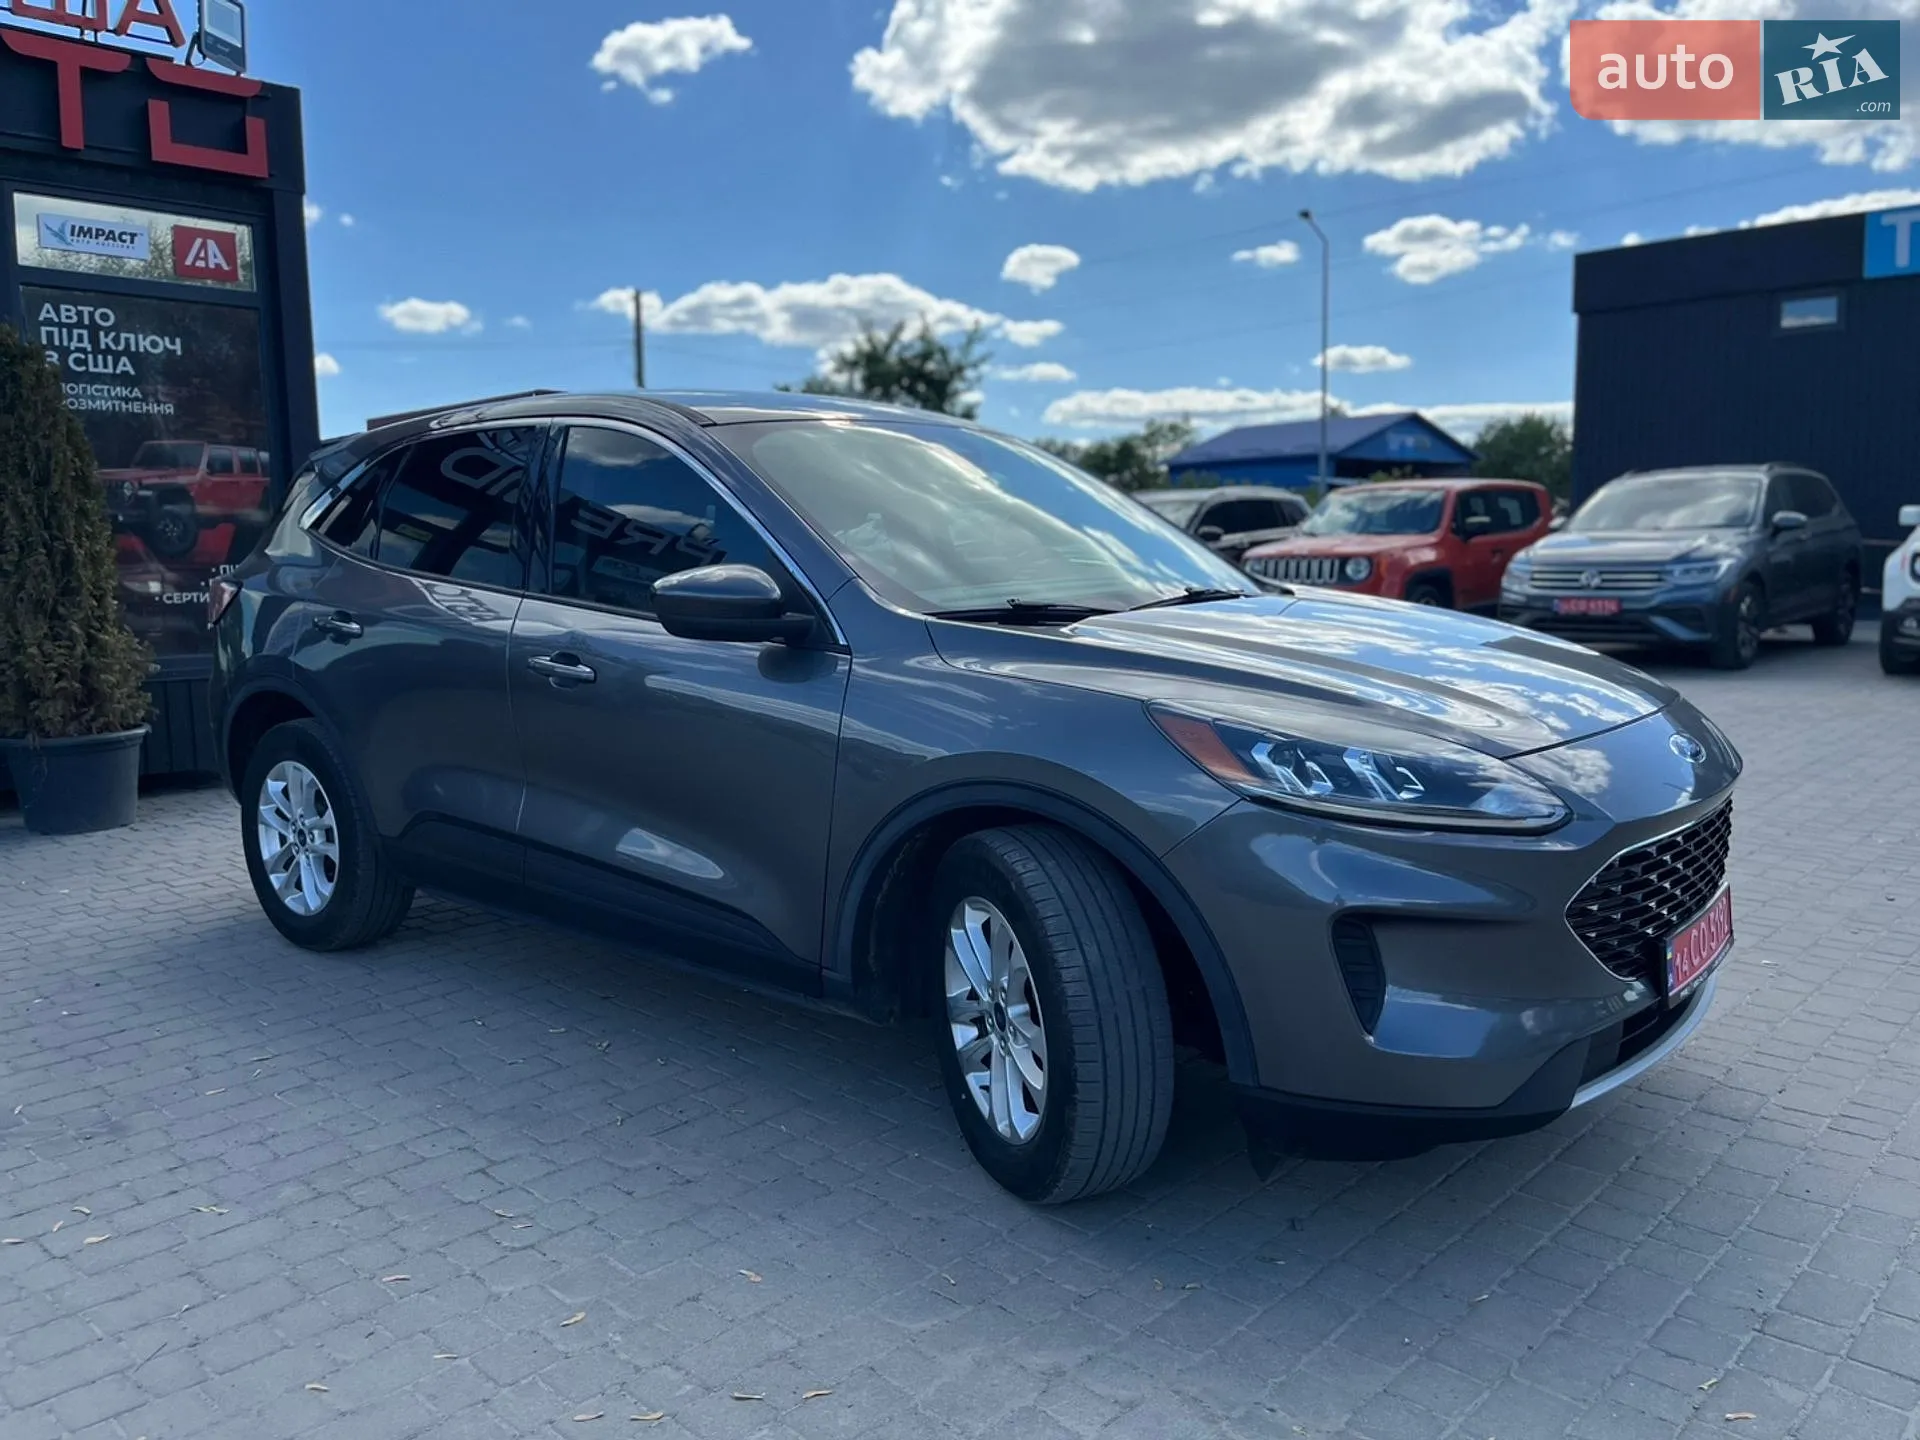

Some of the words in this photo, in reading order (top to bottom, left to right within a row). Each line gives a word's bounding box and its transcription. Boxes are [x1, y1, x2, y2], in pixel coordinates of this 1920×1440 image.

[69, 223, 138, 245] IMPACT
[38, 302, 116, 328] АВТО
[39, 326, 93, 351] ПІД
[99, 330, 183, 356] КЛЮЧ
[67, 352, 136, 376] США
[61, 398, 175, 416] ОЗМИТНЕННЯ
